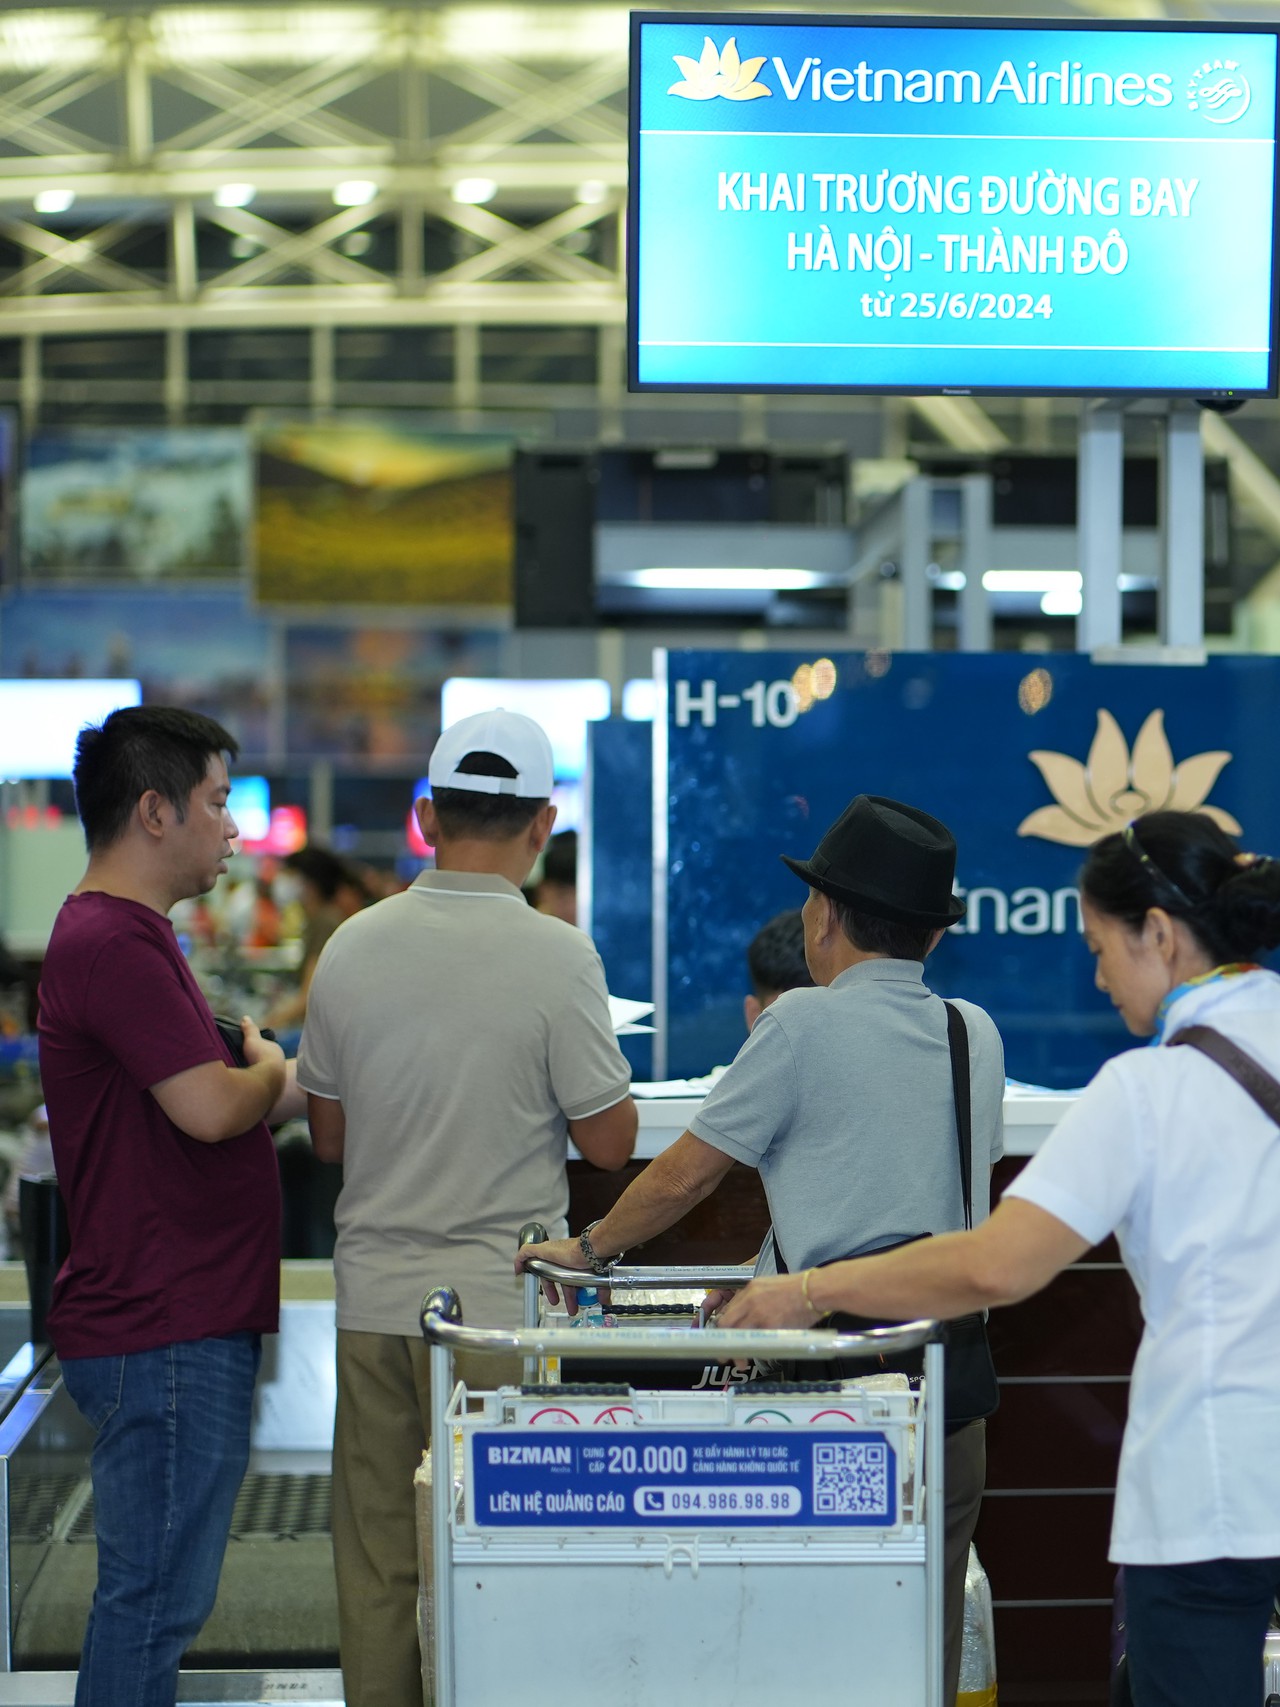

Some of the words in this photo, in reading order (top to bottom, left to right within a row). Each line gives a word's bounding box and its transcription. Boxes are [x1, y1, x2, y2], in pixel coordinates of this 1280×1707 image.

[772, 56, 982, 105] Vietnam
[985, 59, 1173, 108] Airlines
[718, 172, 806, 213] KHAI
[812, 169, 971, 215] TRƯƠNG
[979, 169, 1120, 217] ĐƯỜNG
[1129, 178, 1200, 218] BAY
[787, 225, 840, 272] HÀ
[847, 226, 912, 282] NỘI
[938, 227, 1065, 275] THÀNH
[1071, 229, 1130, 275] ĐÔ
[860, 291, 895, 320] từ
[899, 293, 1054, 321] 25/6/2024
[675, 679, 800, 728] H-10
[488, 1446, 572, 1465] BIZMAN
[583, 1447, 605, 1458] CUNG
[608, 1446, 687, 1473] 20.000
[693, 1447, 704, 1458] XE
[489, 1490, 521, 1512] LIÊN
[524, 1490, 543, 1515] HỆ
[545, 1488, 594, 1513] QUẢNG
[596, 1490, 626, 1512] CÁO
[671, 1492, 791, 1511] 094.986.98.98
